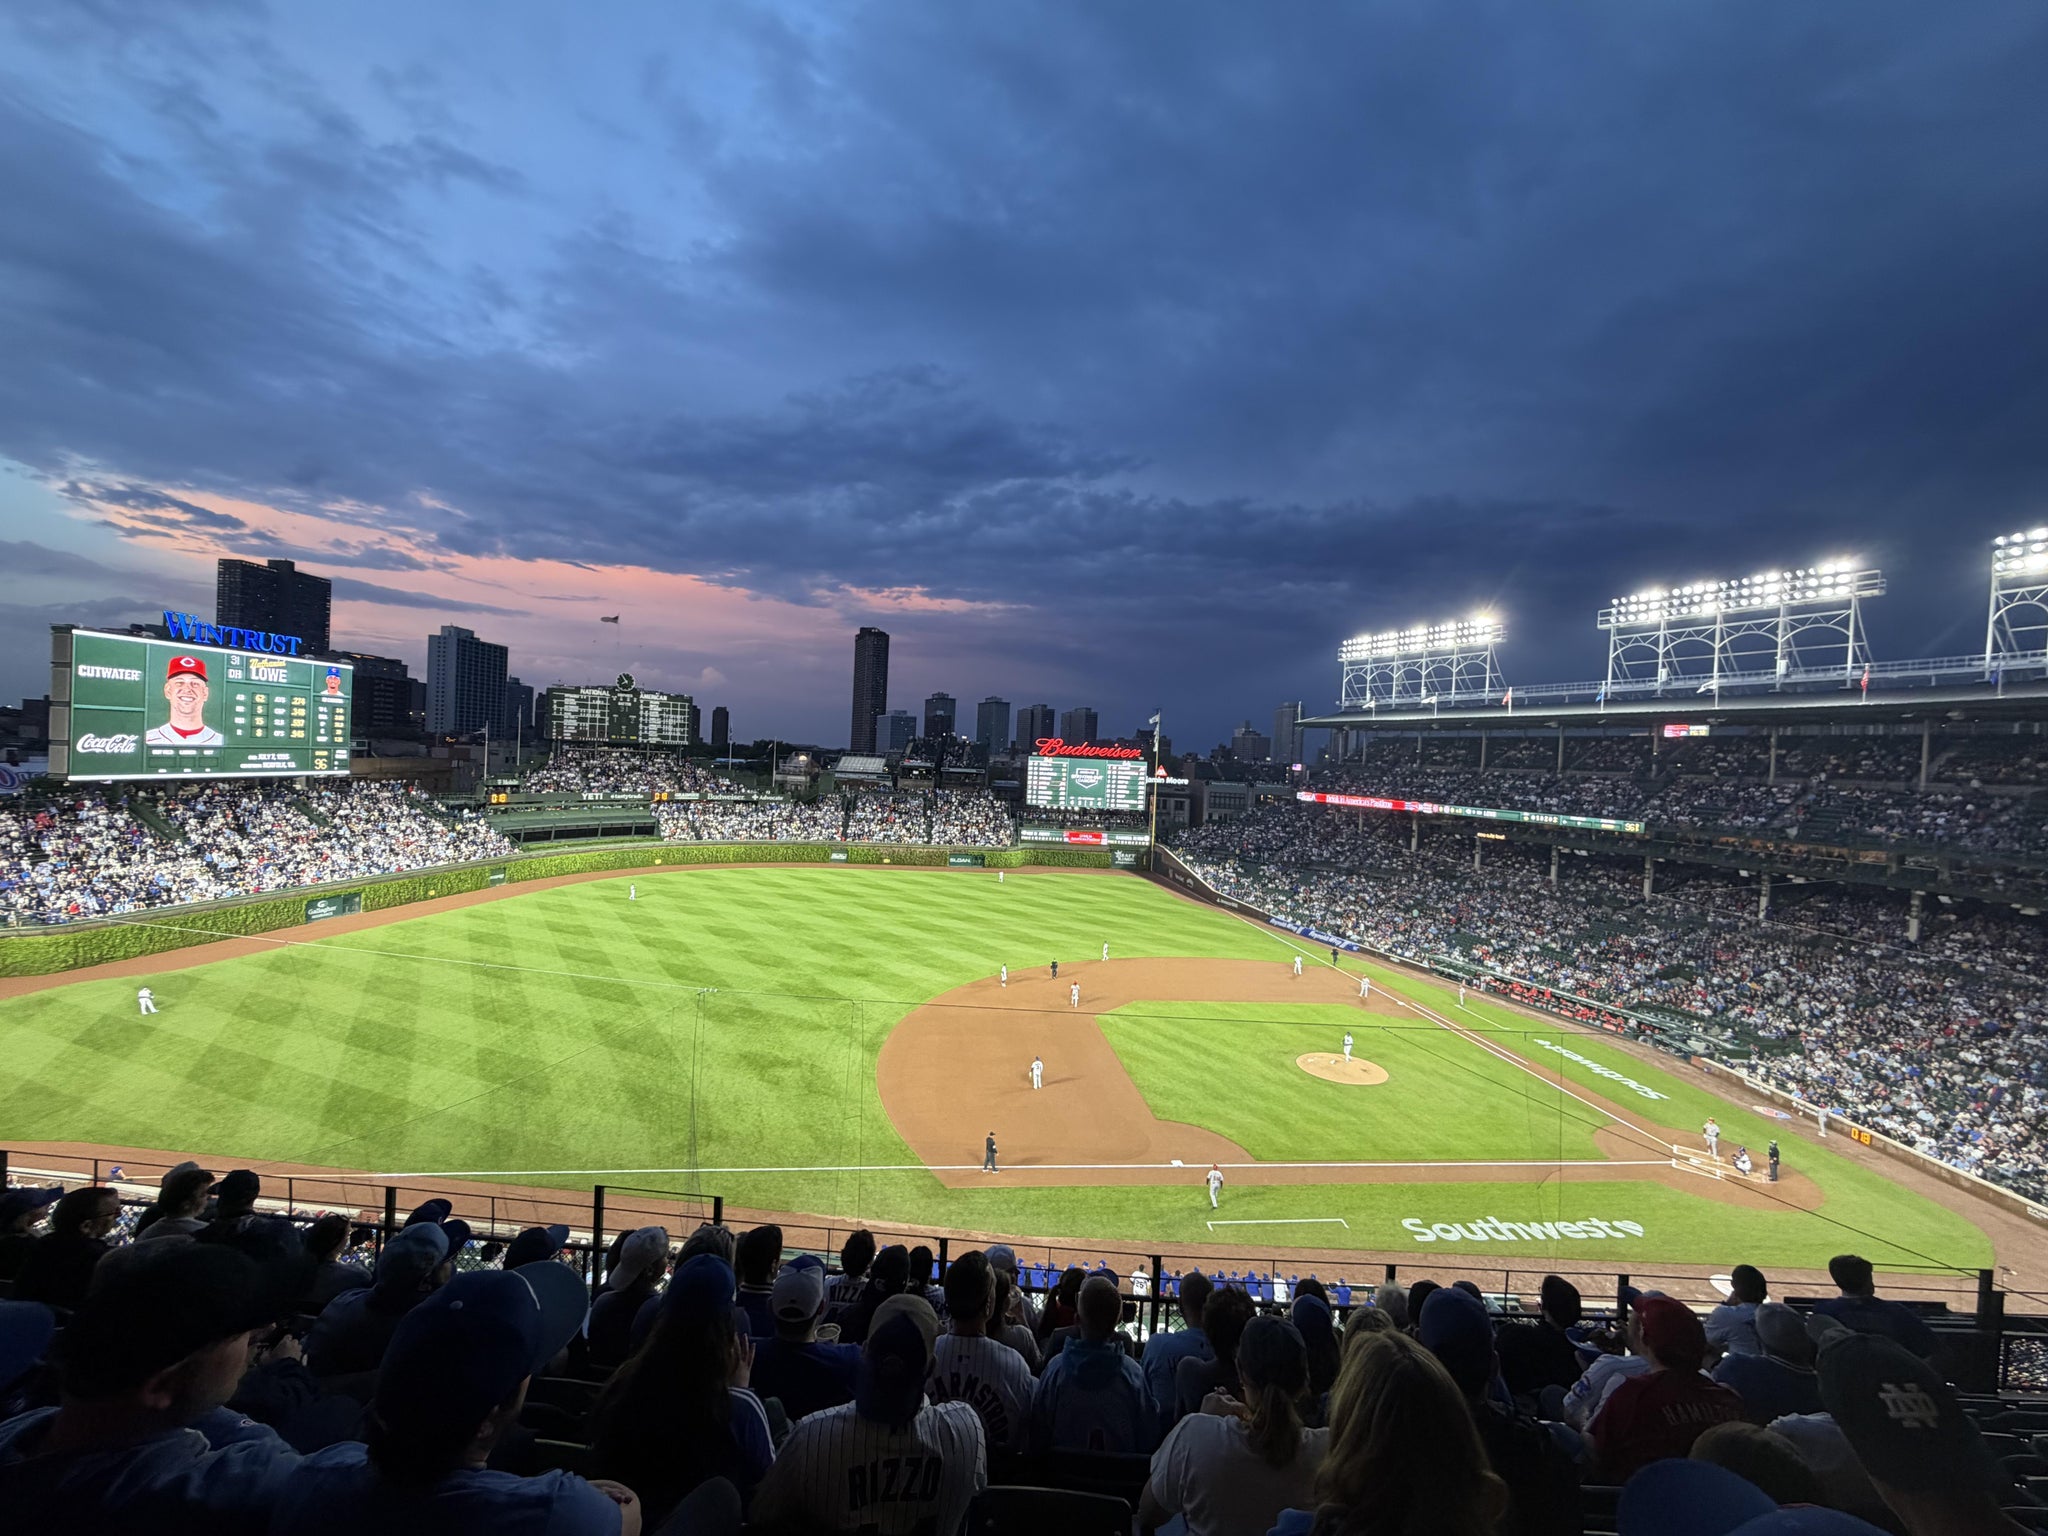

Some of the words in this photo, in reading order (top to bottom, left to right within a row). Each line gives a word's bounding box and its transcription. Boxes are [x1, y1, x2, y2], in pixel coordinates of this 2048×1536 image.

[163, 610, 302, 655] WINTRUST
[231, 655, 241, 665] 31
[77, 664, 141, 681] CUTWATER
[227, 668, 242, 679] DH
[250, 667, 288, 683] LOWE
[580, 688, 610, 696] NATIONAL
[640, 693, 668, 701] AMERICAN
[1035, 738, 1142, 758] Budweiser
[314, 758, 328, 770] 96
[1166, 777, 1189, 785] Moore
[582, 792, 603, 800] YETI
[707, 792, 745, 800] Budweiser
[308, 905, 337, 915] Gallagher
[1552, 1044, 1671, 1100] Southwest
[1401, 1216, 1626, 1242] Southwest
[848, 1457, 942, 1511] RIZZO
